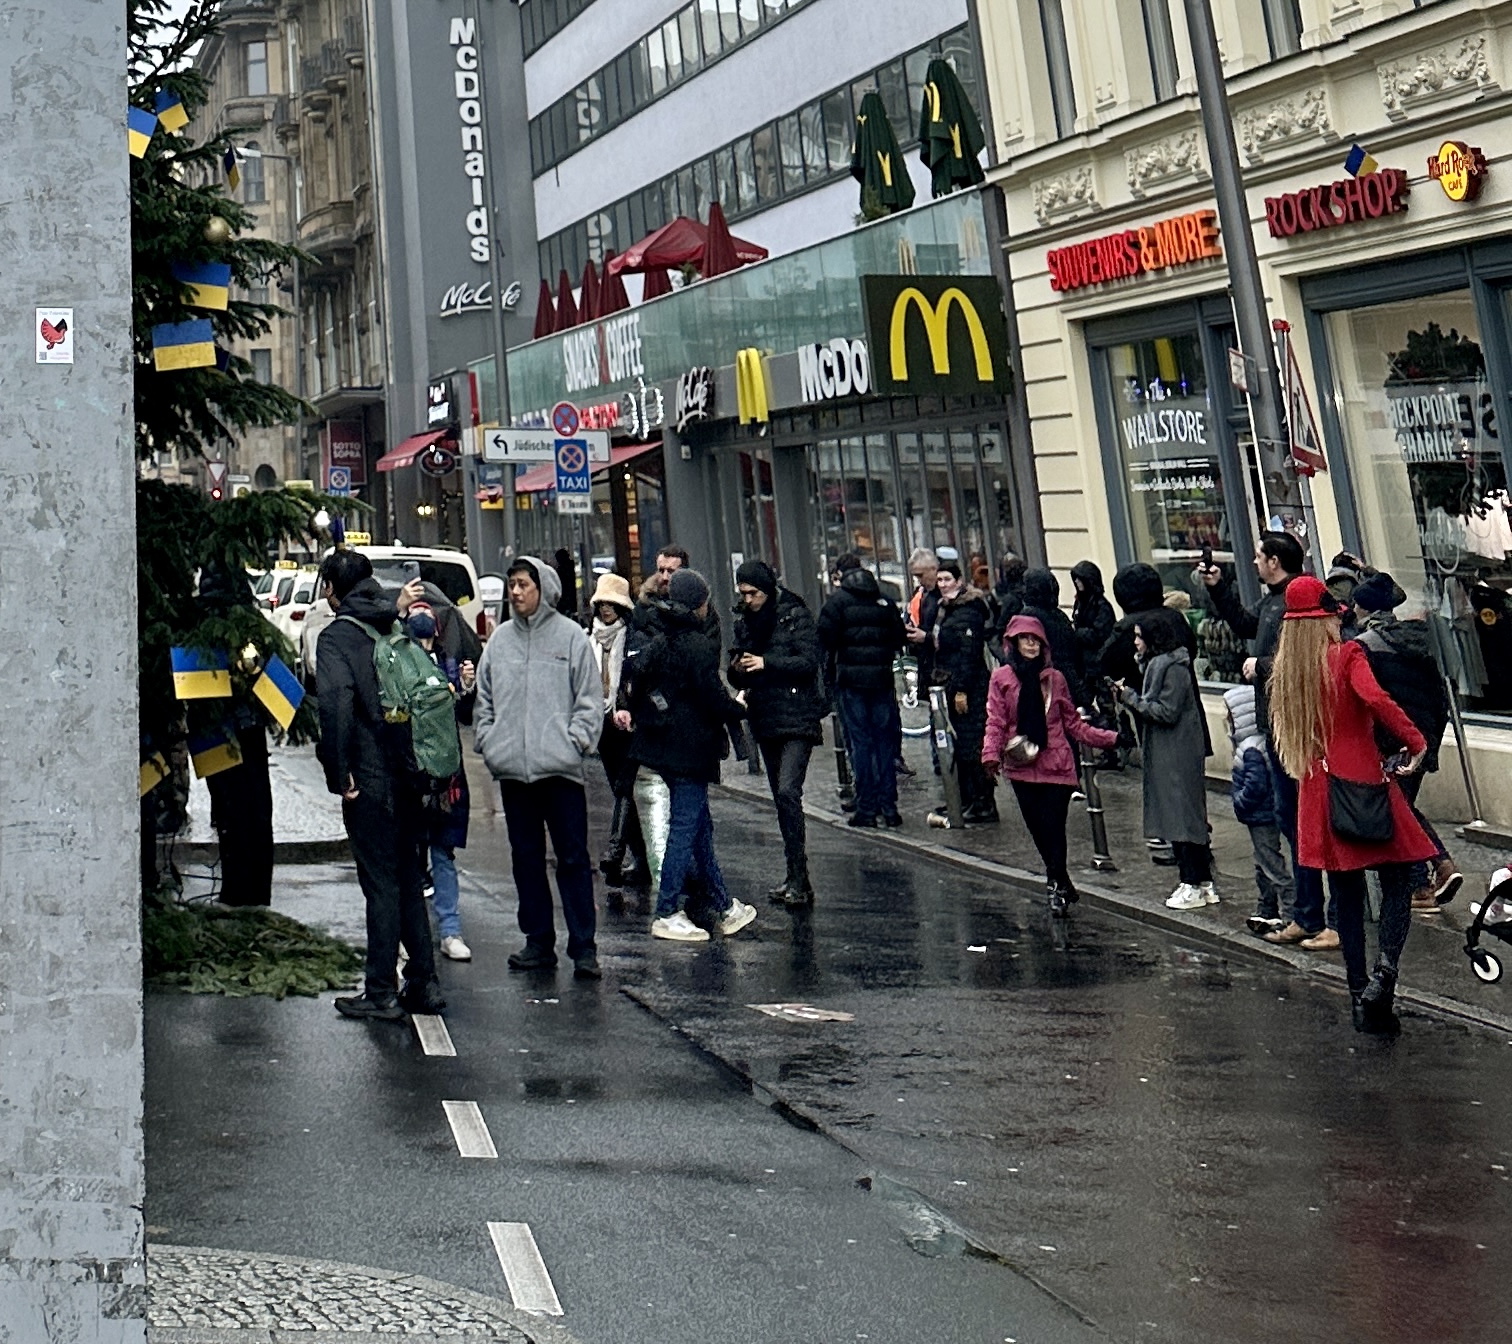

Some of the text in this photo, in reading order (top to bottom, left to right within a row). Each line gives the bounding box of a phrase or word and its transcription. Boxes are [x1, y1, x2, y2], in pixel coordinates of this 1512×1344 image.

[1264, 168, 1402, 238] ROCK SHOP
[1047, 209, 1223, 291] SOUVENIRS & MORE
[606, 312, 645, 384] COFFEE
[332, 441, 361, 451] SOTTO
[1122, 409, 1207, 449] WALLSTORE
[558, 475, 588, 490] TAXI
